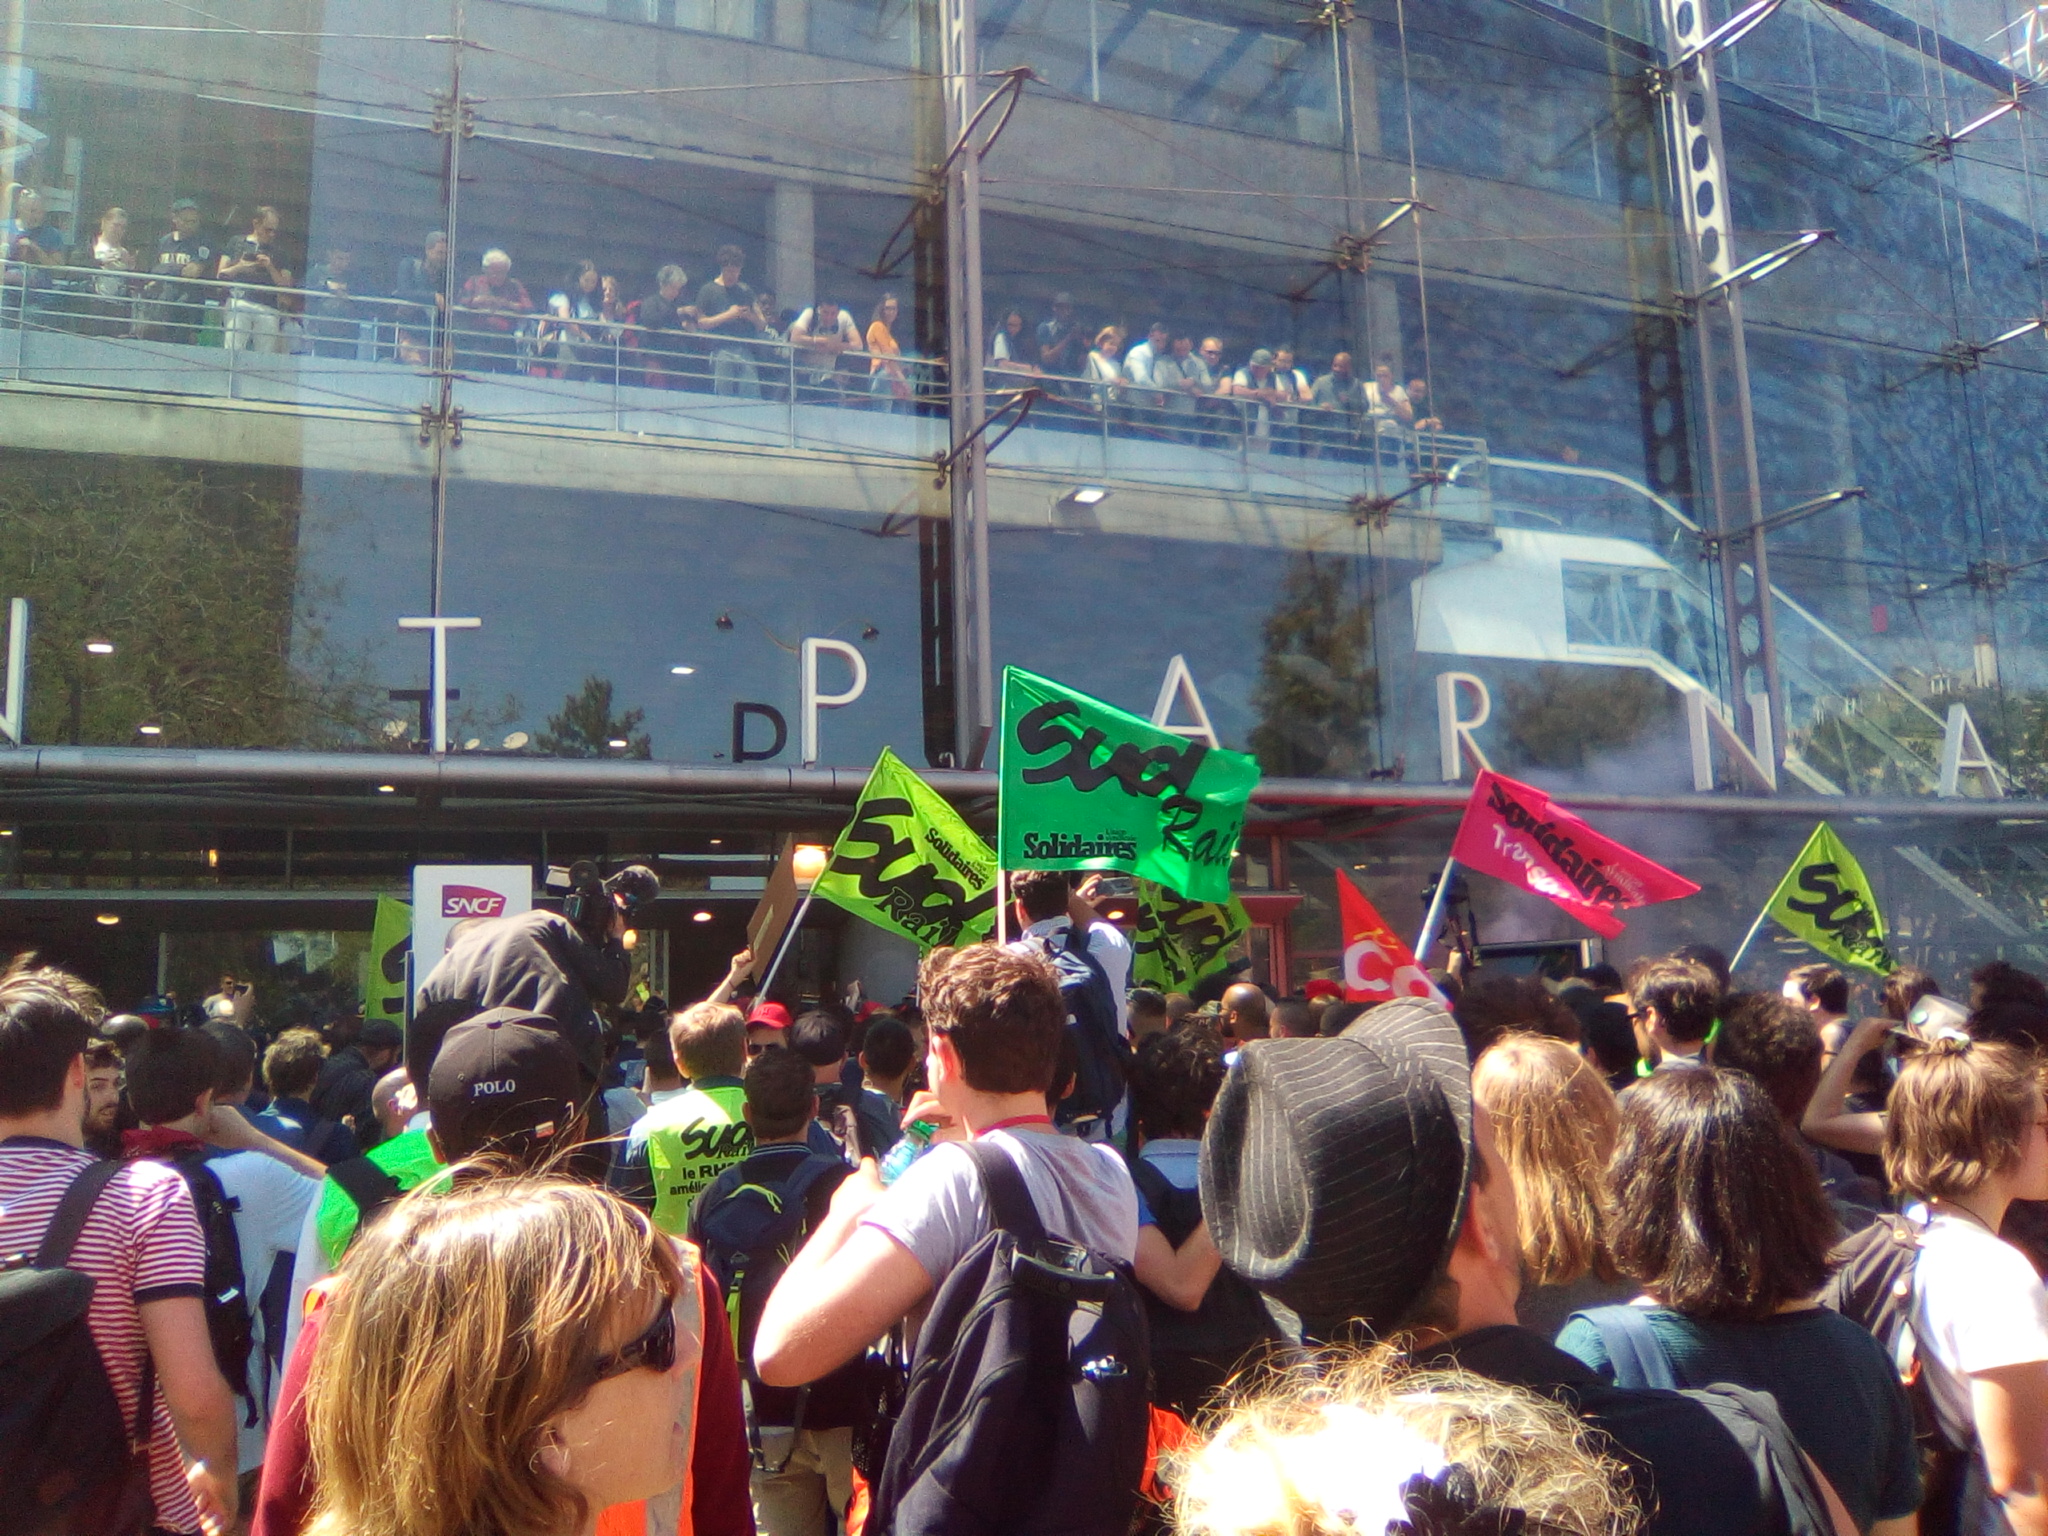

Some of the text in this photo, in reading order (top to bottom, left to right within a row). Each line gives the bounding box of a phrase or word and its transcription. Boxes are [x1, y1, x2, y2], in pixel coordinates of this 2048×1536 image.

[802, 637, 868, 767] P
[1017, 701, 1210, 798] Sud
[924, 827, 987, 890] Solidaires
[1023, 832, 1136, 860] Solidaires
[445, 897, 502, 914] SNCF
[474, 1079, 516, 1097] POLO
[683, 1167, 696, 1180] le
